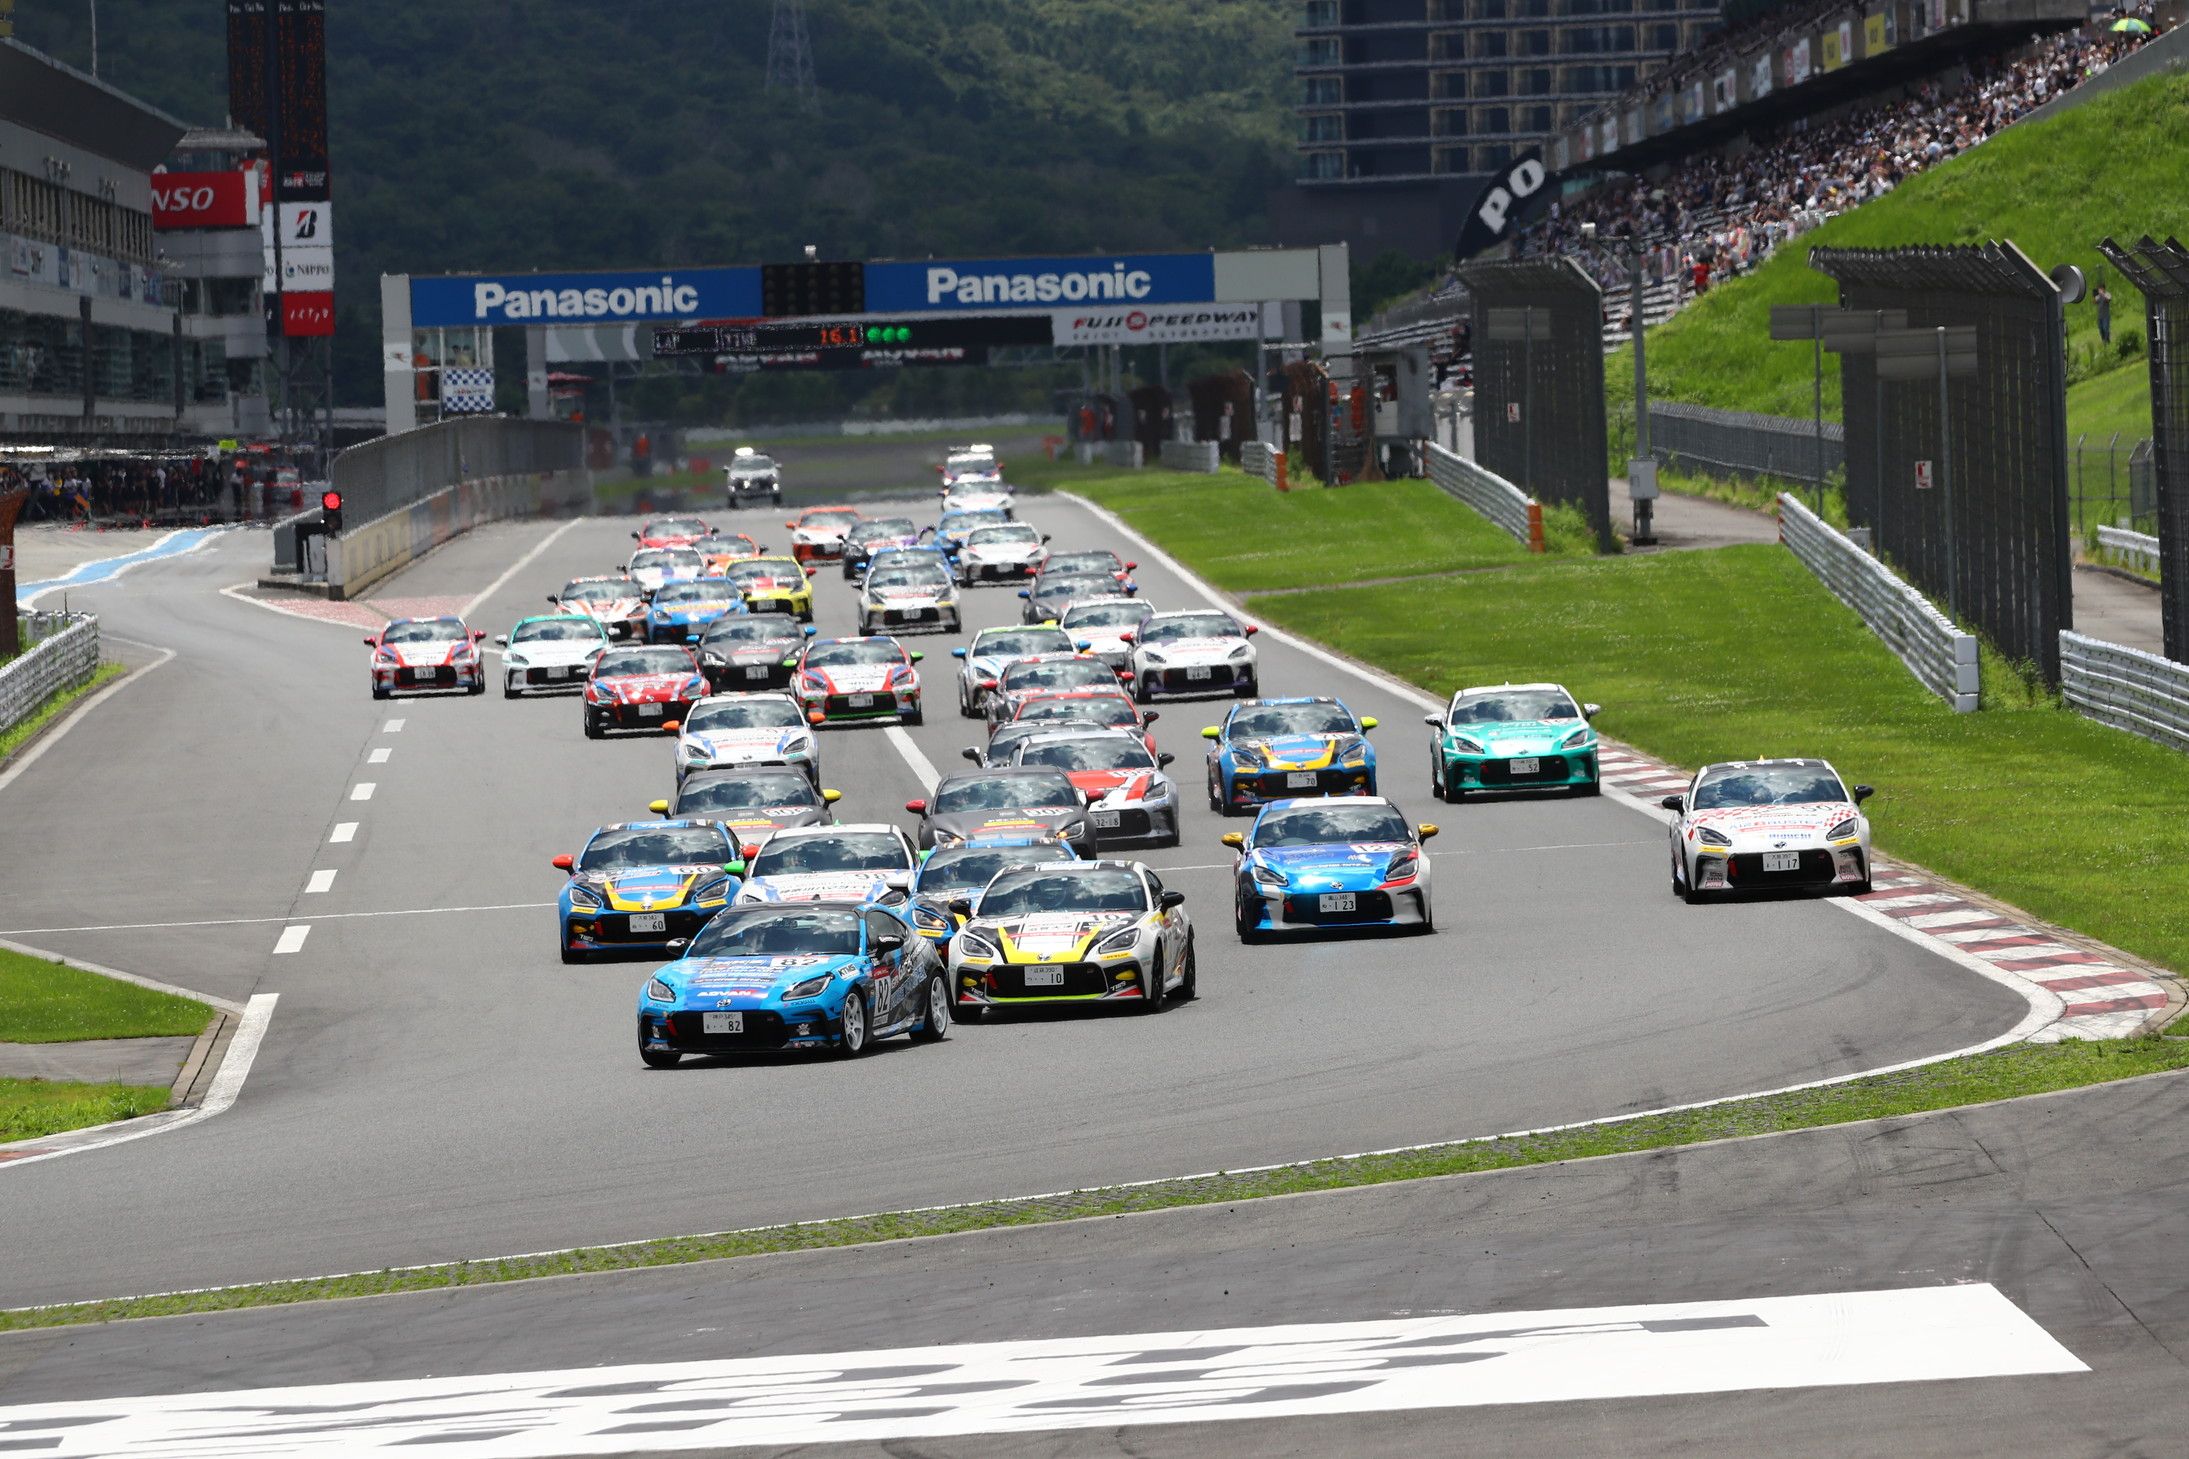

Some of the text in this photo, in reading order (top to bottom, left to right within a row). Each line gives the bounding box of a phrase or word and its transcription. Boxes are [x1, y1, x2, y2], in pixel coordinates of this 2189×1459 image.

[927, 262, 1151, 303] Panasonic
[475, 276, 698, 318] Panasonic
[1073, 315, 1124, 330] FUJI
[819, 326, 859, 344] 16.1
[681, 866, 713, 874] 60
[652, 921, 663, 930] 60
[780, 957, 818, 966] 82
[838, 964, 856, 977] KTMS
[1051, 974, 1062, 984] 10
[697, 990, 753, 998] ADVAN
[877, 977, 889, 1014] 82
[728, 1021, 741, 1031] 82
